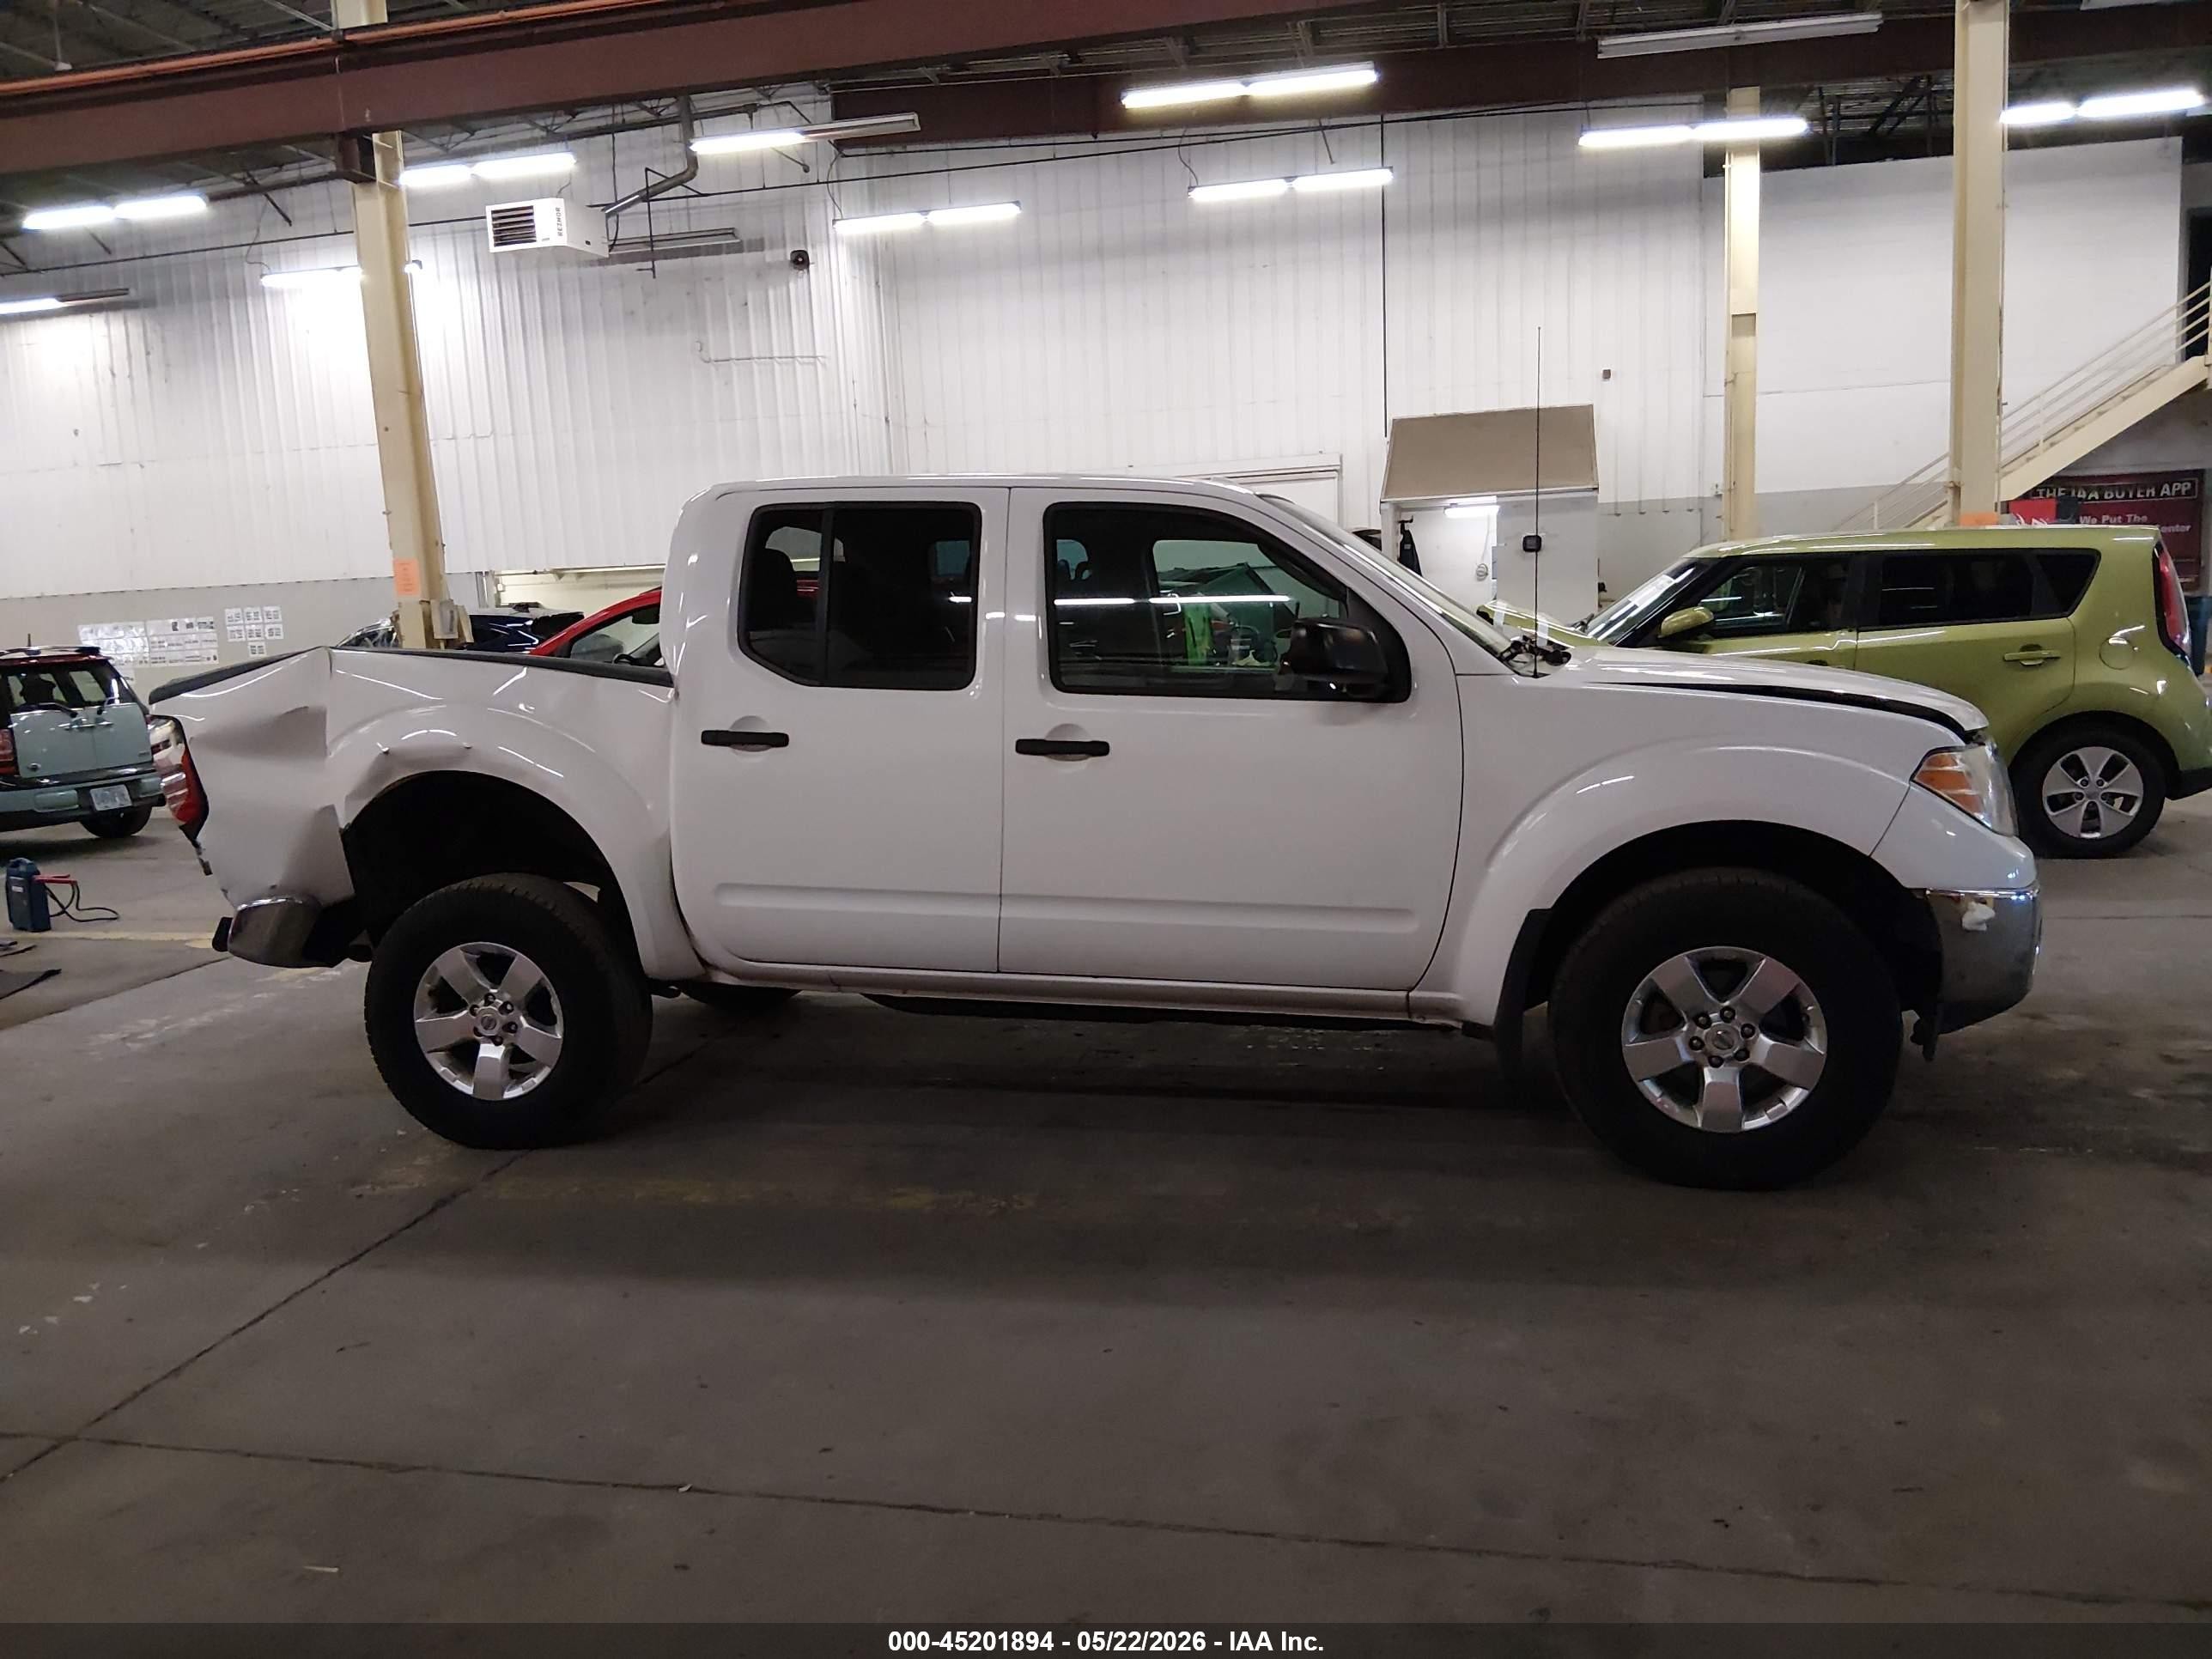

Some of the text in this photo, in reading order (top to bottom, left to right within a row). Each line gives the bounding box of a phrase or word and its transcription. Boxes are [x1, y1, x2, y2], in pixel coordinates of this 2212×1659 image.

[2160, 482, 2192, 497] APP
[2079, 514, 2148, 525] We Put The
[2159, 524, 2191, 533] enter
